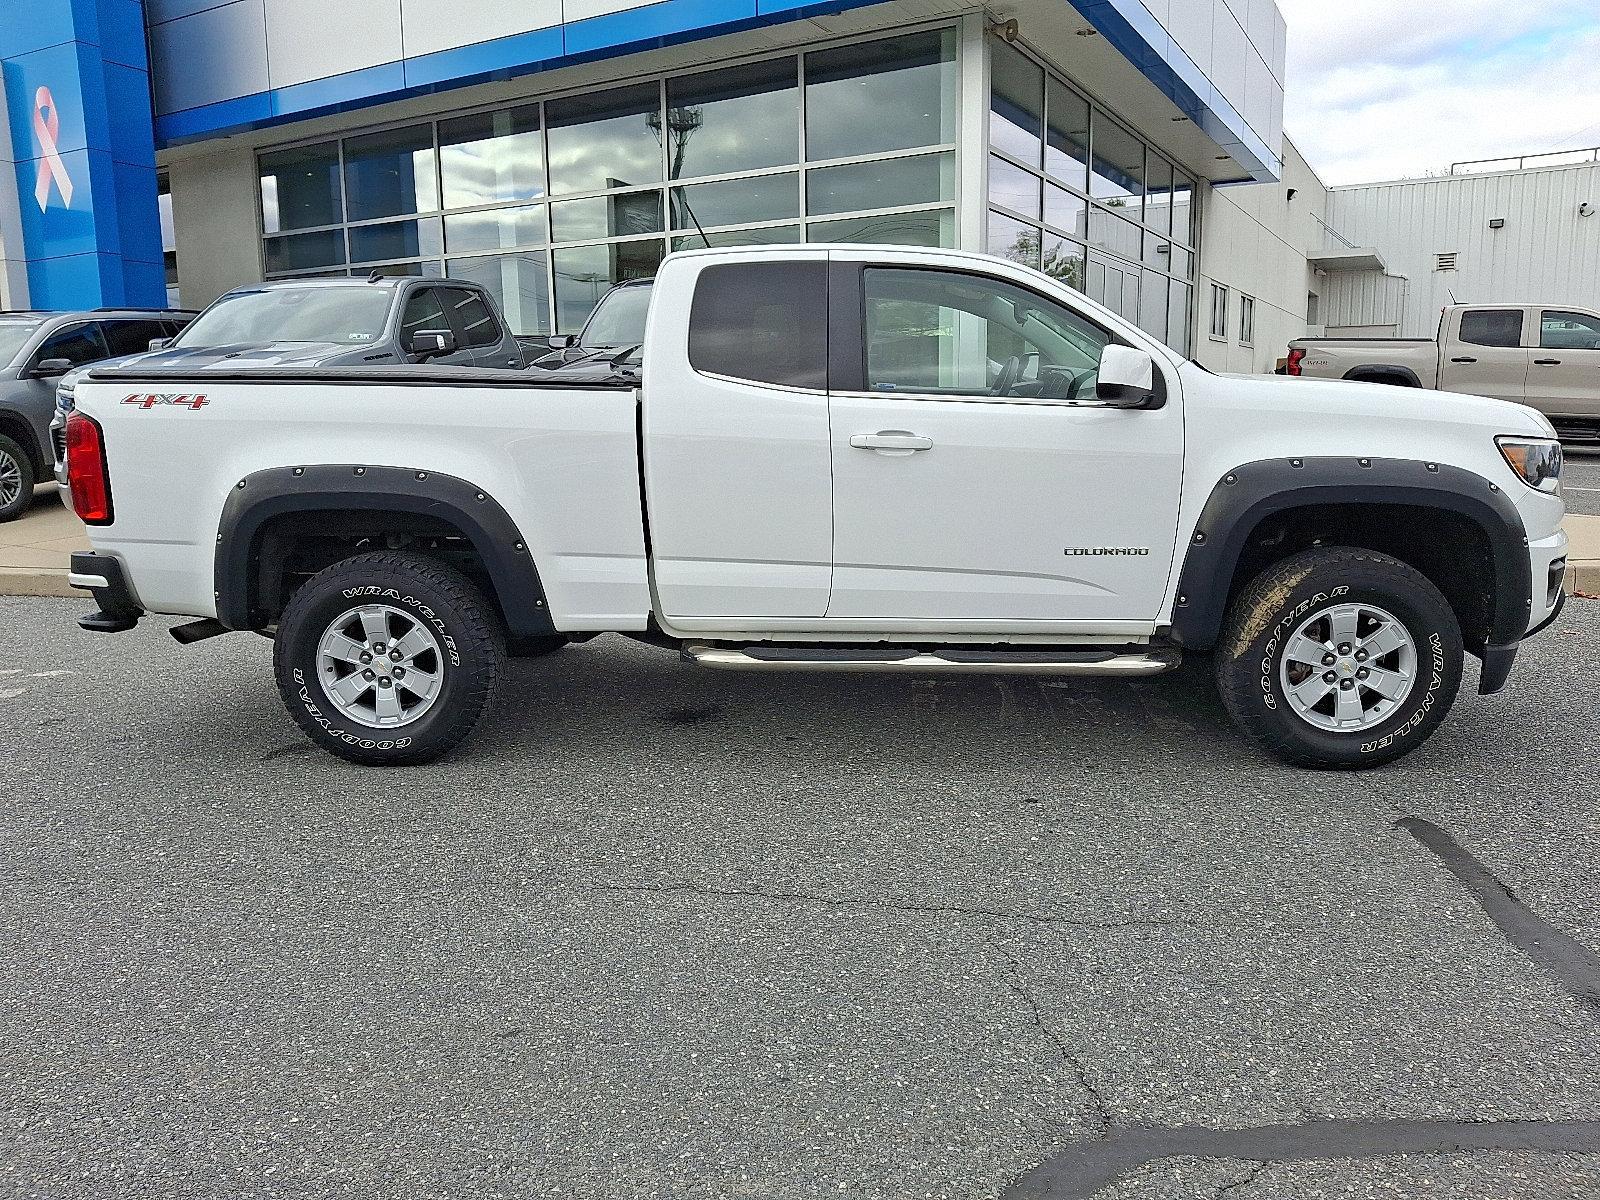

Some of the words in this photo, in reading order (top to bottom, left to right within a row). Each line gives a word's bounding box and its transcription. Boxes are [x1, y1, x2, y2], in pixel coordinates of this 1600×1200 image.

[1063, 547, 1150, 556] COLORADO
[342, 585, 461, 667] WRANGLER
[1261, 585, 1350, 711] GOODYEAR
[293, 668, 412, 750] GOODYEAR
[1360, 632, 1444, 753] WRANGLER
